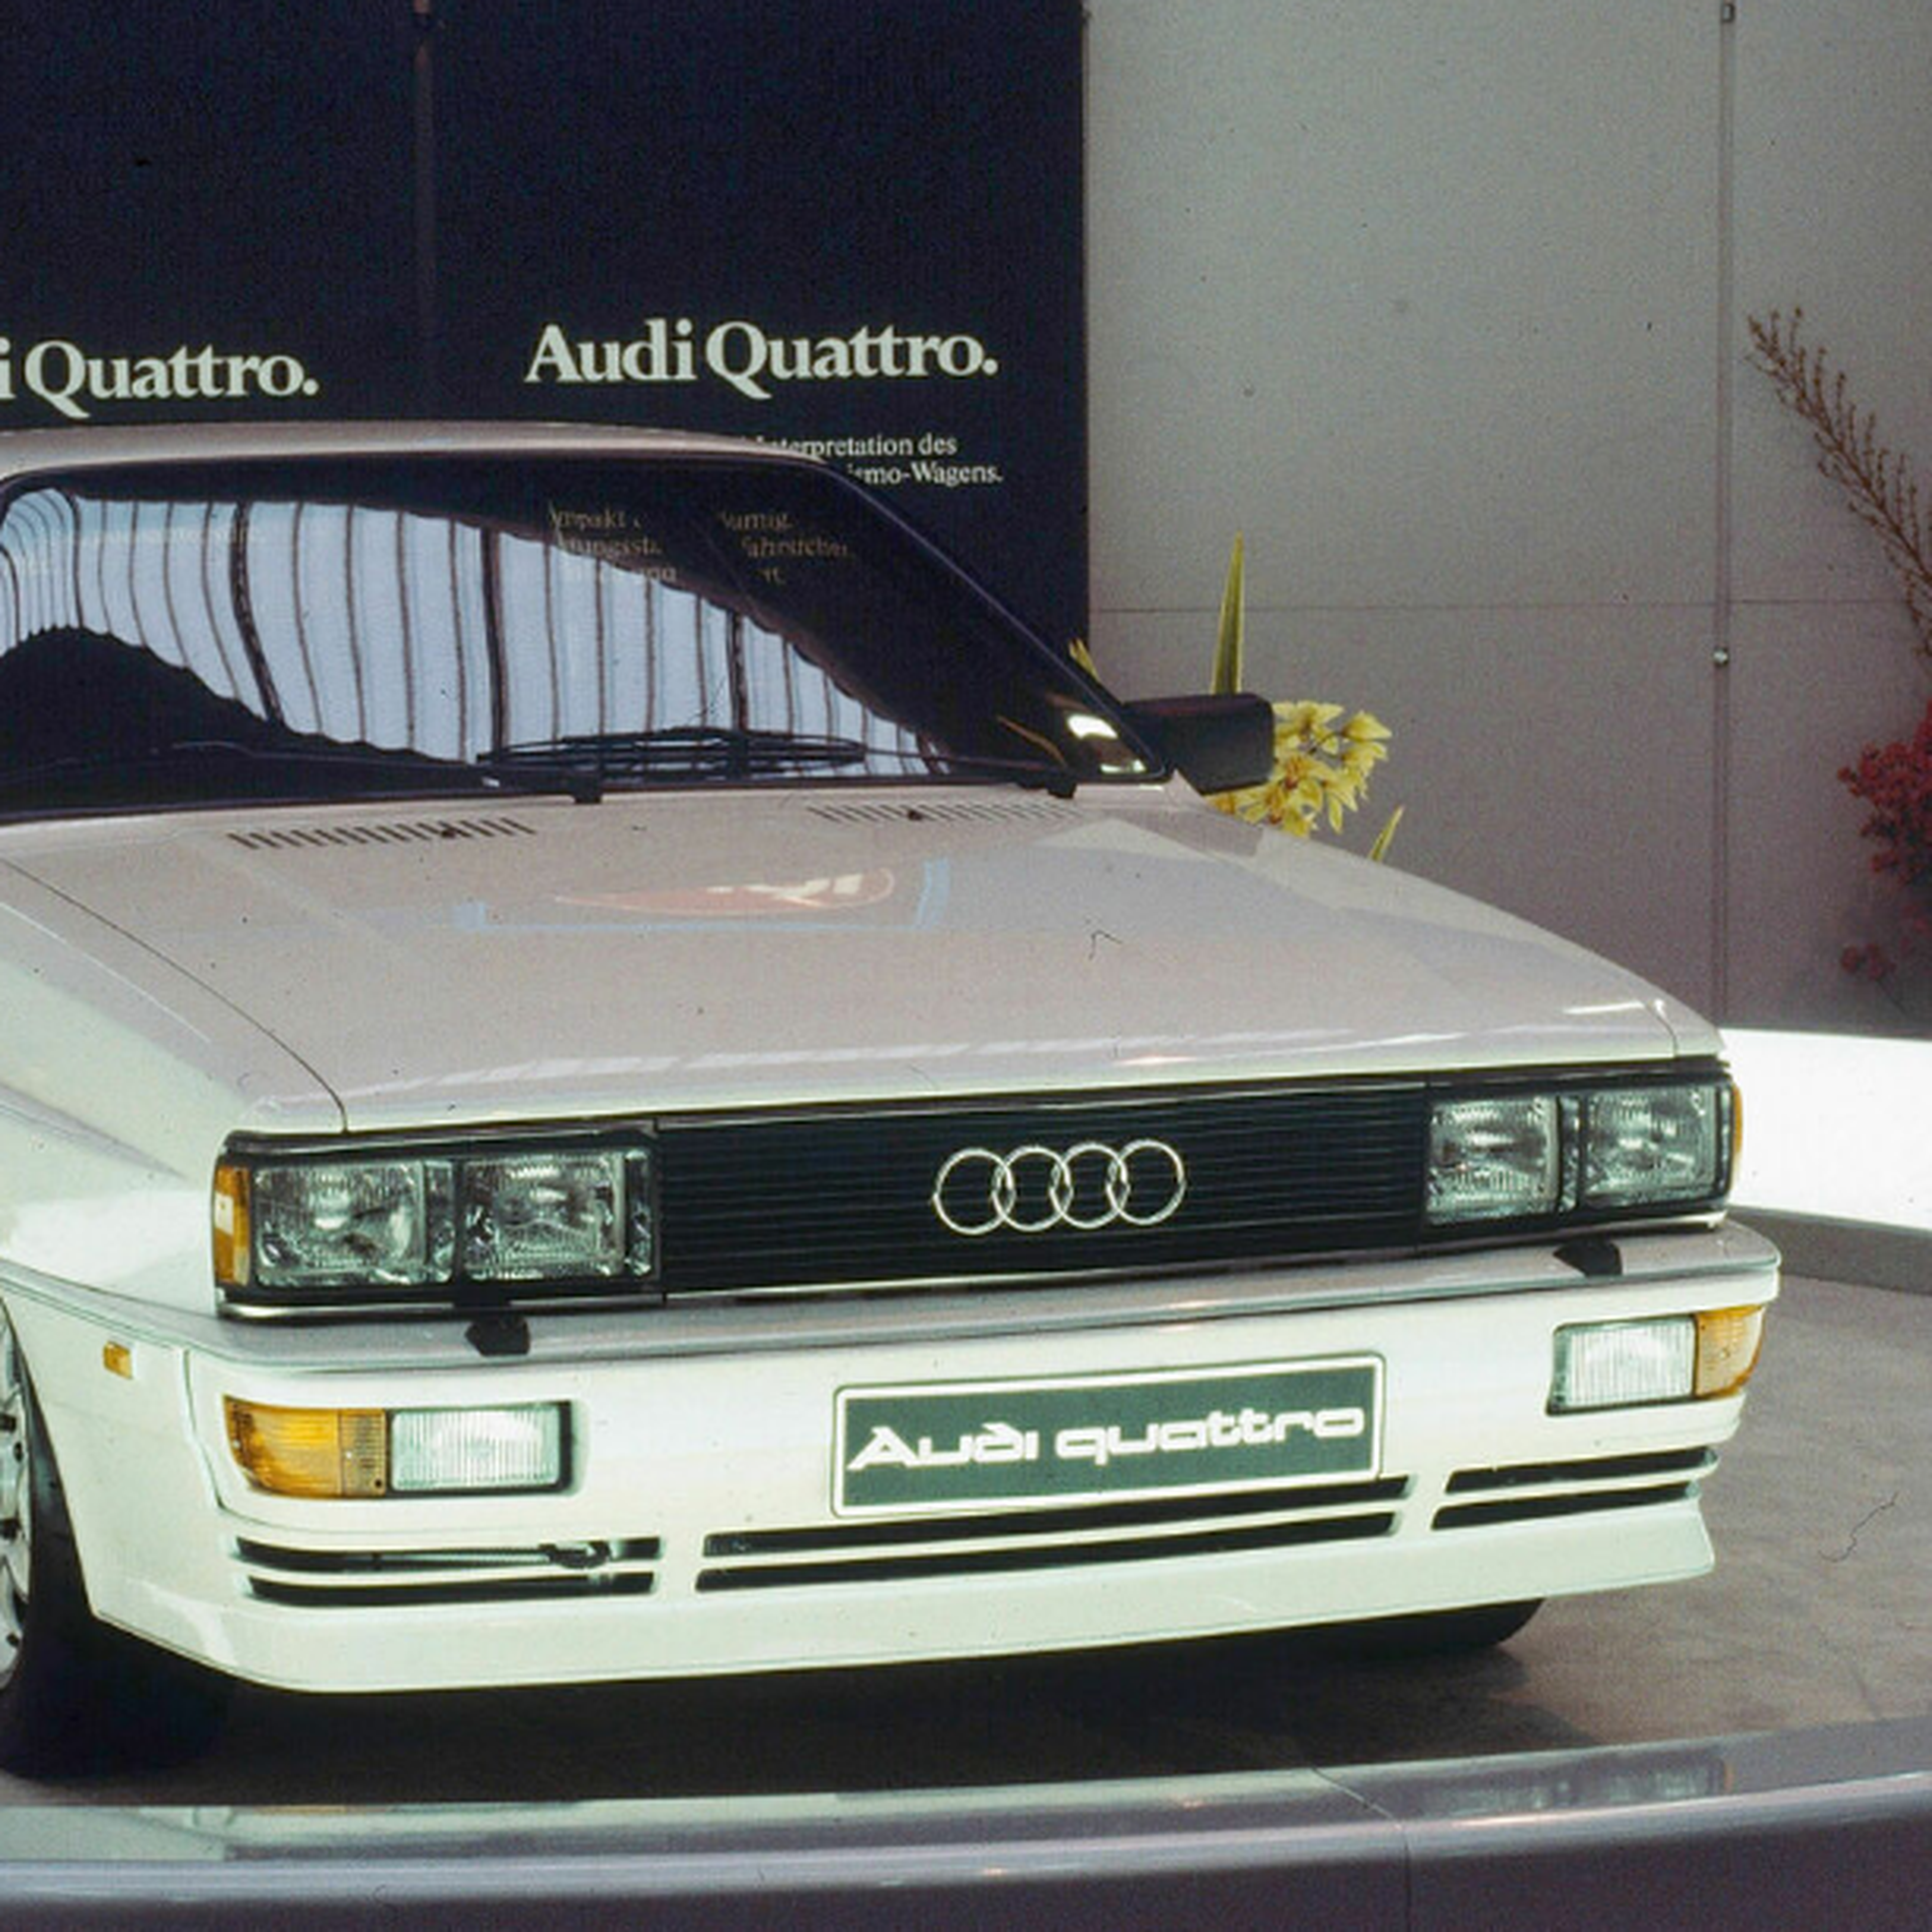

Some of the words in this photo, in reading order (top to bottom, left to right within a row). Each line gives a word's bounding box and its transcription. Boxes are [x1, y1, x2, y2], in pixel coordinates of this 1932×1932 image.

[25, 341, 318, 419] Quattro.
[525, 318, 697, 382] Audi
[705, 321, 998, 399] Quattro.
[918, 433, 957, 455] des
[847, 1422, 1038, 1470] Audi
[1056, 1407, 1364, 1466] quattro
